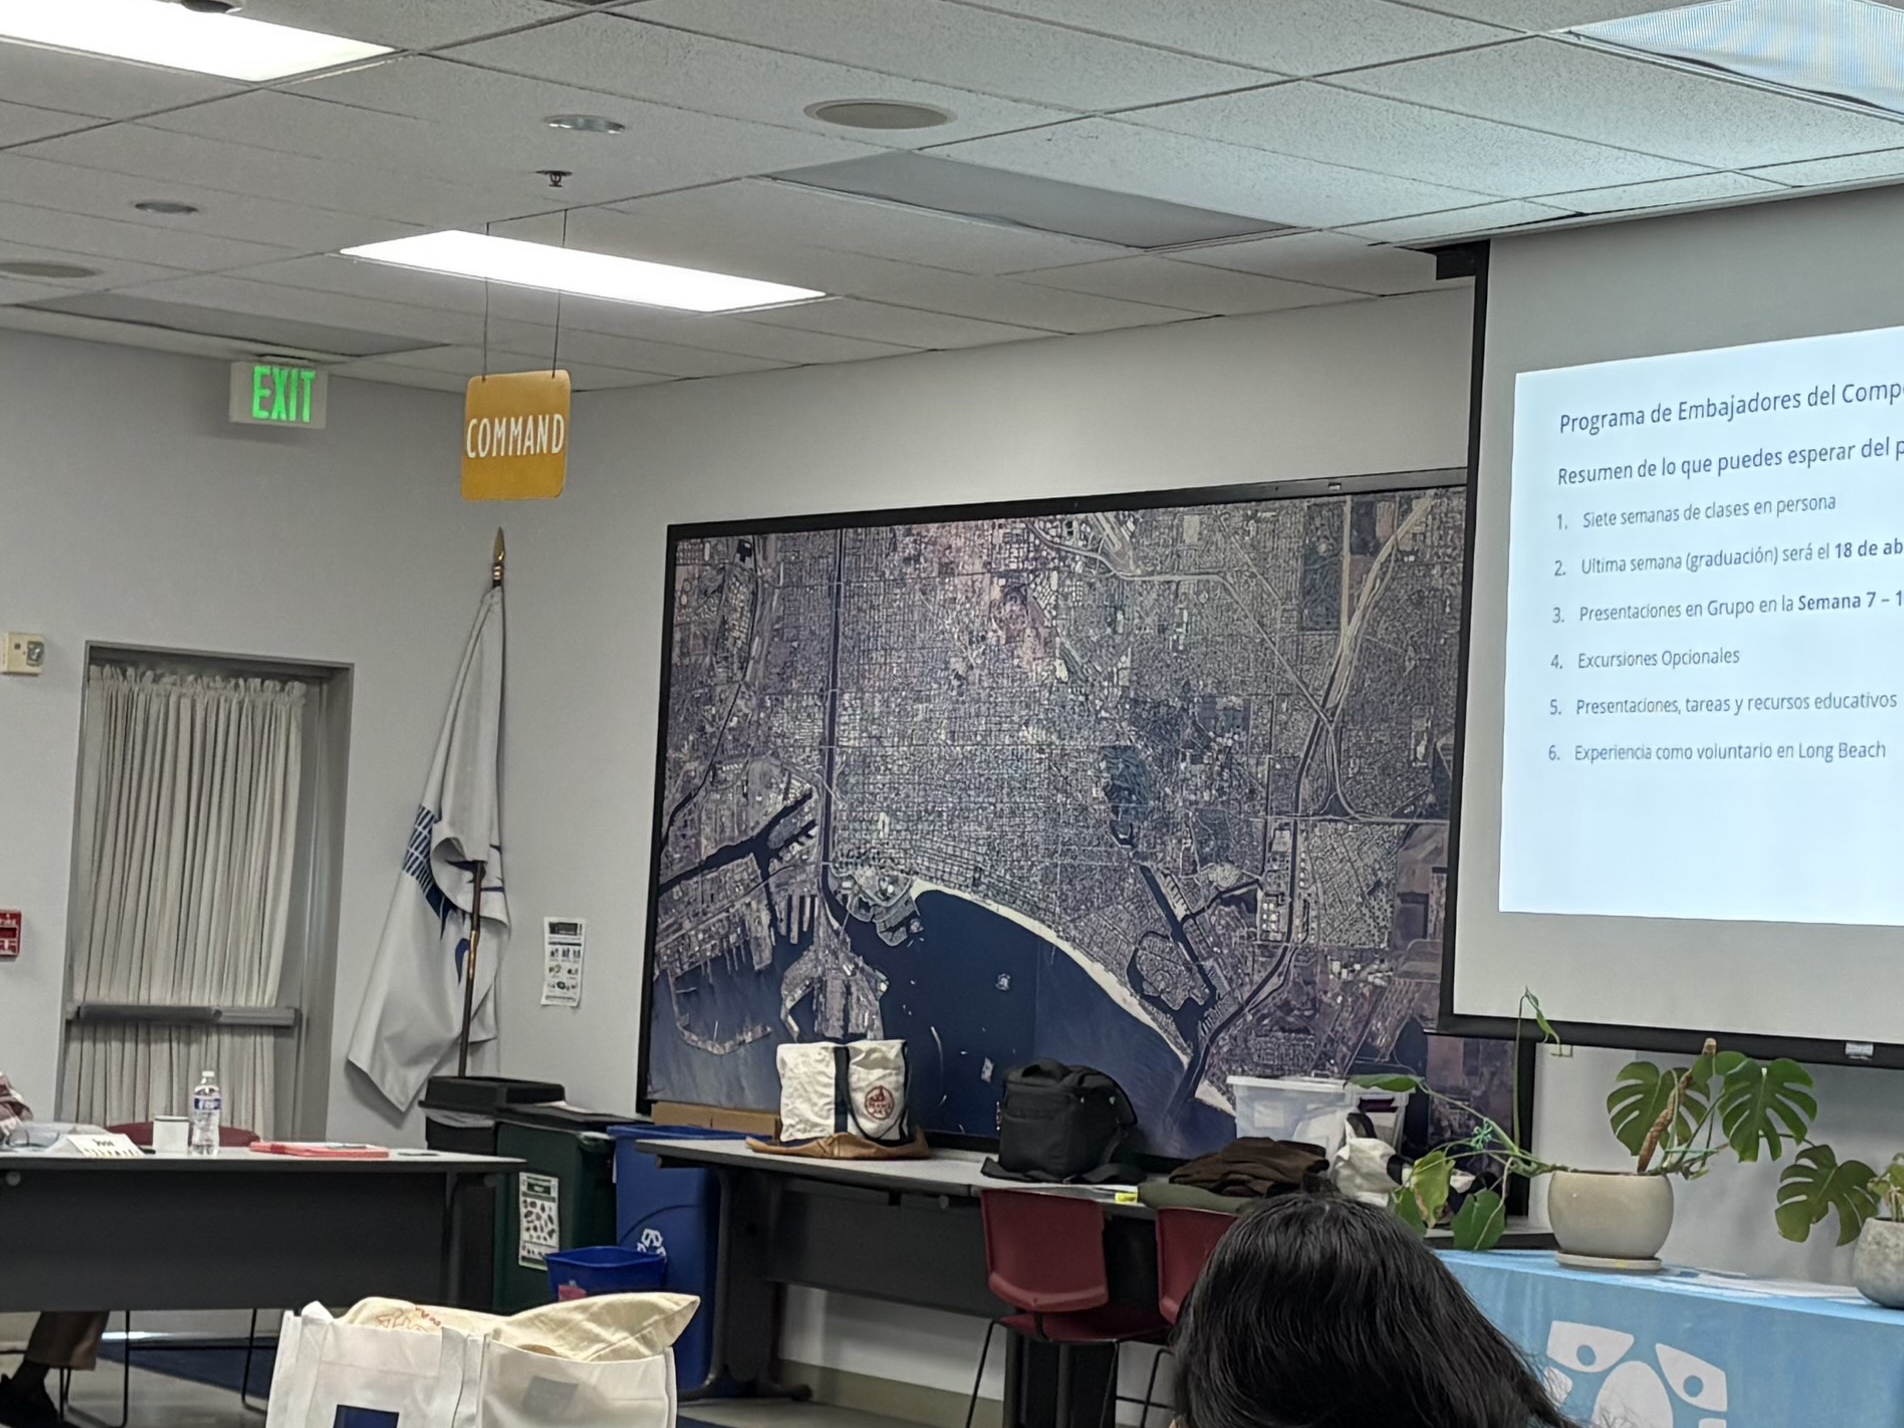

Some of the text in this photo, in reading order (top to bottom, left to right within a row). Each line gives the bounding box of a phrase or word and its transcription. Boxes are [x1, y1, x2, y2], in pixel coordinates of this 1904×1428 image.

[252, 365, 316, 423] EXIT
[1559, 408, 1645, 436] Programa
[1650, 403, 1672, 424] de
[1678, 391, 1802, 422] Embajadores
[1807, 384, 1836, 407] del
[465, 413, 566, 458] COMMAND
[1557, 463, 1634, 486] Resumen
[1637, 458, 1658, 479] de
[1661, 457, 1677, 476] lo
[1681, 456, 1713, 480] que
[1717, 448, 1783, 477] puedes
[1787, 442, 1856, 469] esperar
[1860, 435, 1890, 459] del
[1556, 495, 1837, 531] 1. Siete semanas de clases en persona
[1554, 559, 1567, 577] 2.
[1581, 556, 1627, 575] Ultima
[1630, 554, 1683, 573] semana
[1685, 545, 1779, 573] (graduación)
[1782, 542, 1813, 563] será
[1817, 542, 1830, 560] el
[1834, 542, 1853, 559] 18
[1857, 539, 1878, 557] de
[1552, 606, 1565, 624] 3.
[1579, 601, 1683, 622] Presentaciones
[1685, 600, 1704, 618] en
[1707, 598, 1755, 619] Grupo
[1758, 596, 1778, 614] en
[1781, 594, 1795, 612] la
[1797, 592, 1862, 612] Semana
[1865, 591, 1877, 608] 7
[1550, 646, 1741, 670] 4. Excursiones Opcionales
[1549, 691, 1898, 716] 5. Presentaciones, tareas y recursos educativos
[1548, 740, 1887, 765] 6. Experiencia como voluntario en Long Beach
